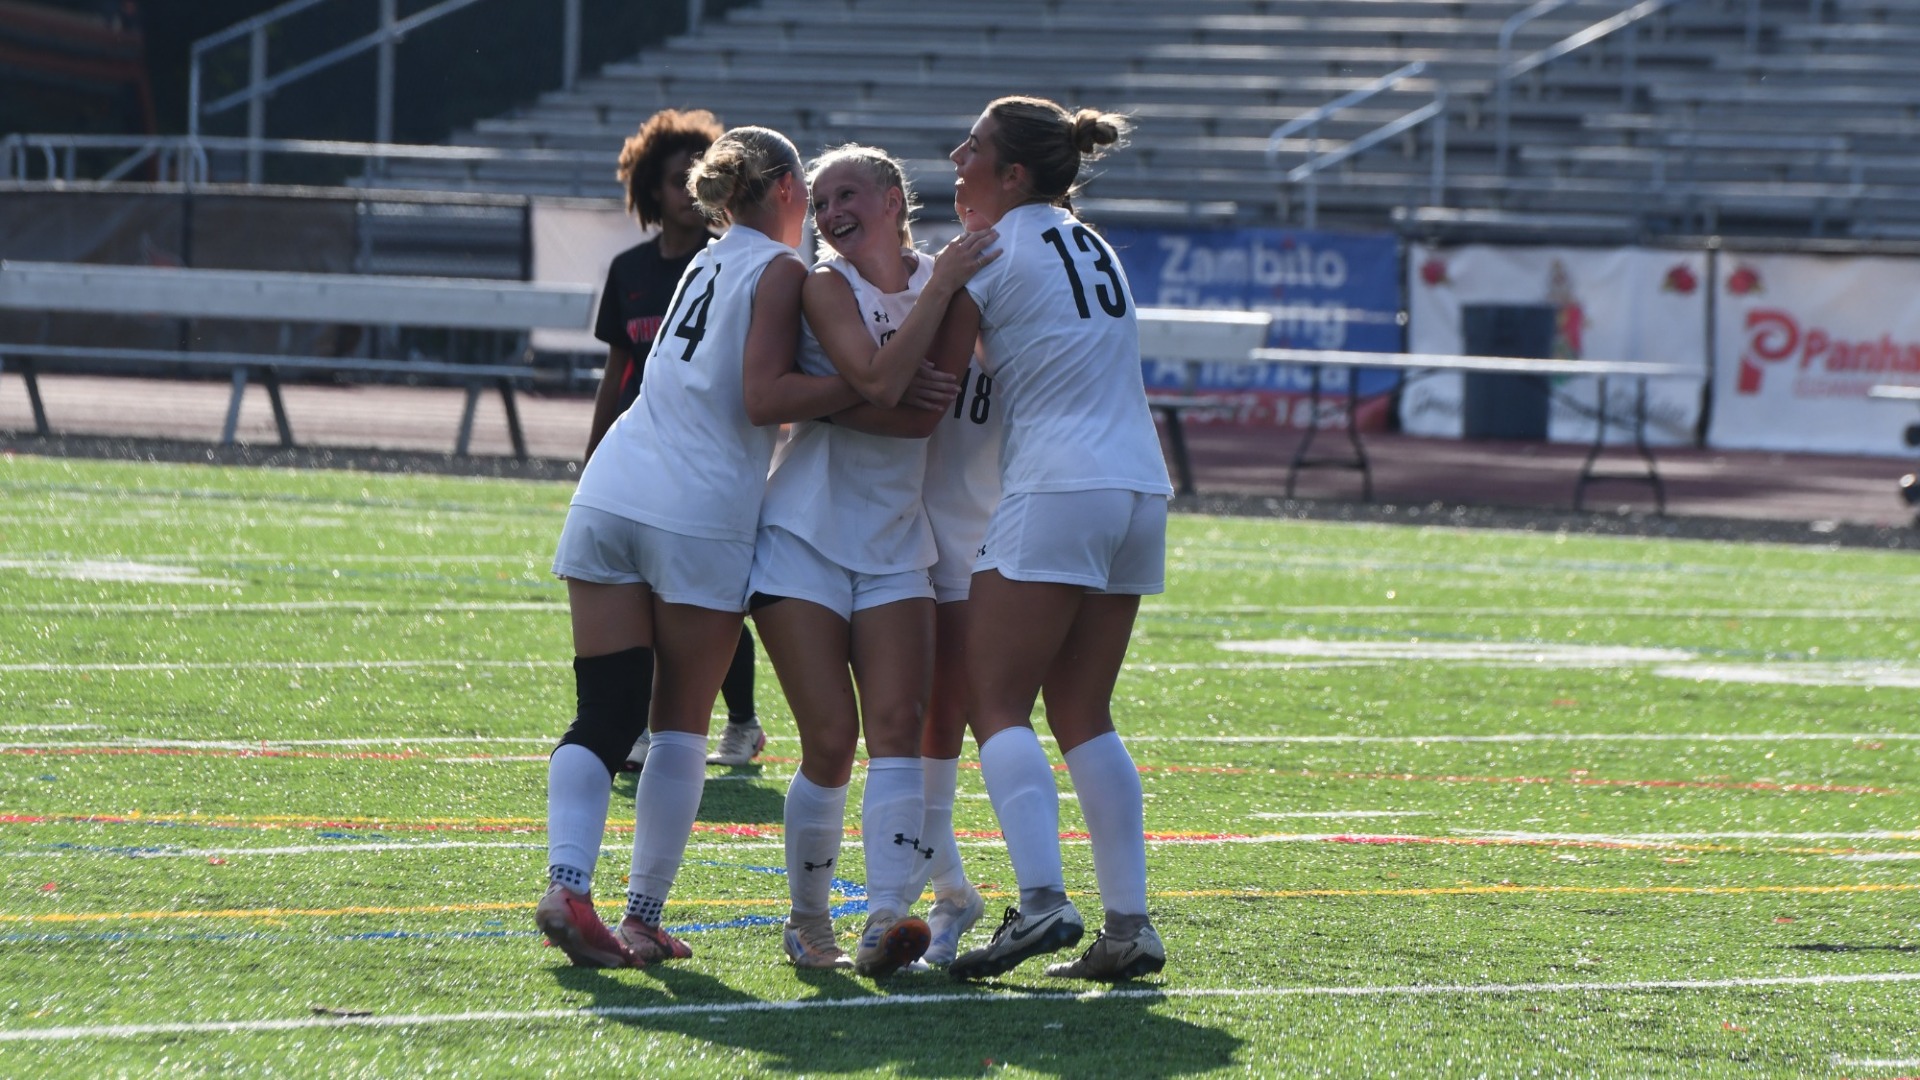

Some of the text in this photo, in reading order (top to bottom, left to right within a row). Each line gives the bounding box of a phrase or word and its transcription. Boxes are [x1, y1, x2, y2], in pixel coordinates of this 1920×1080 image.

[1041, 225, 1126, 319] 13
[1158, 235, 1347, 288] Zambito
[653, 262, 722, 363] 14
[953, 367, 993, 425] 18
